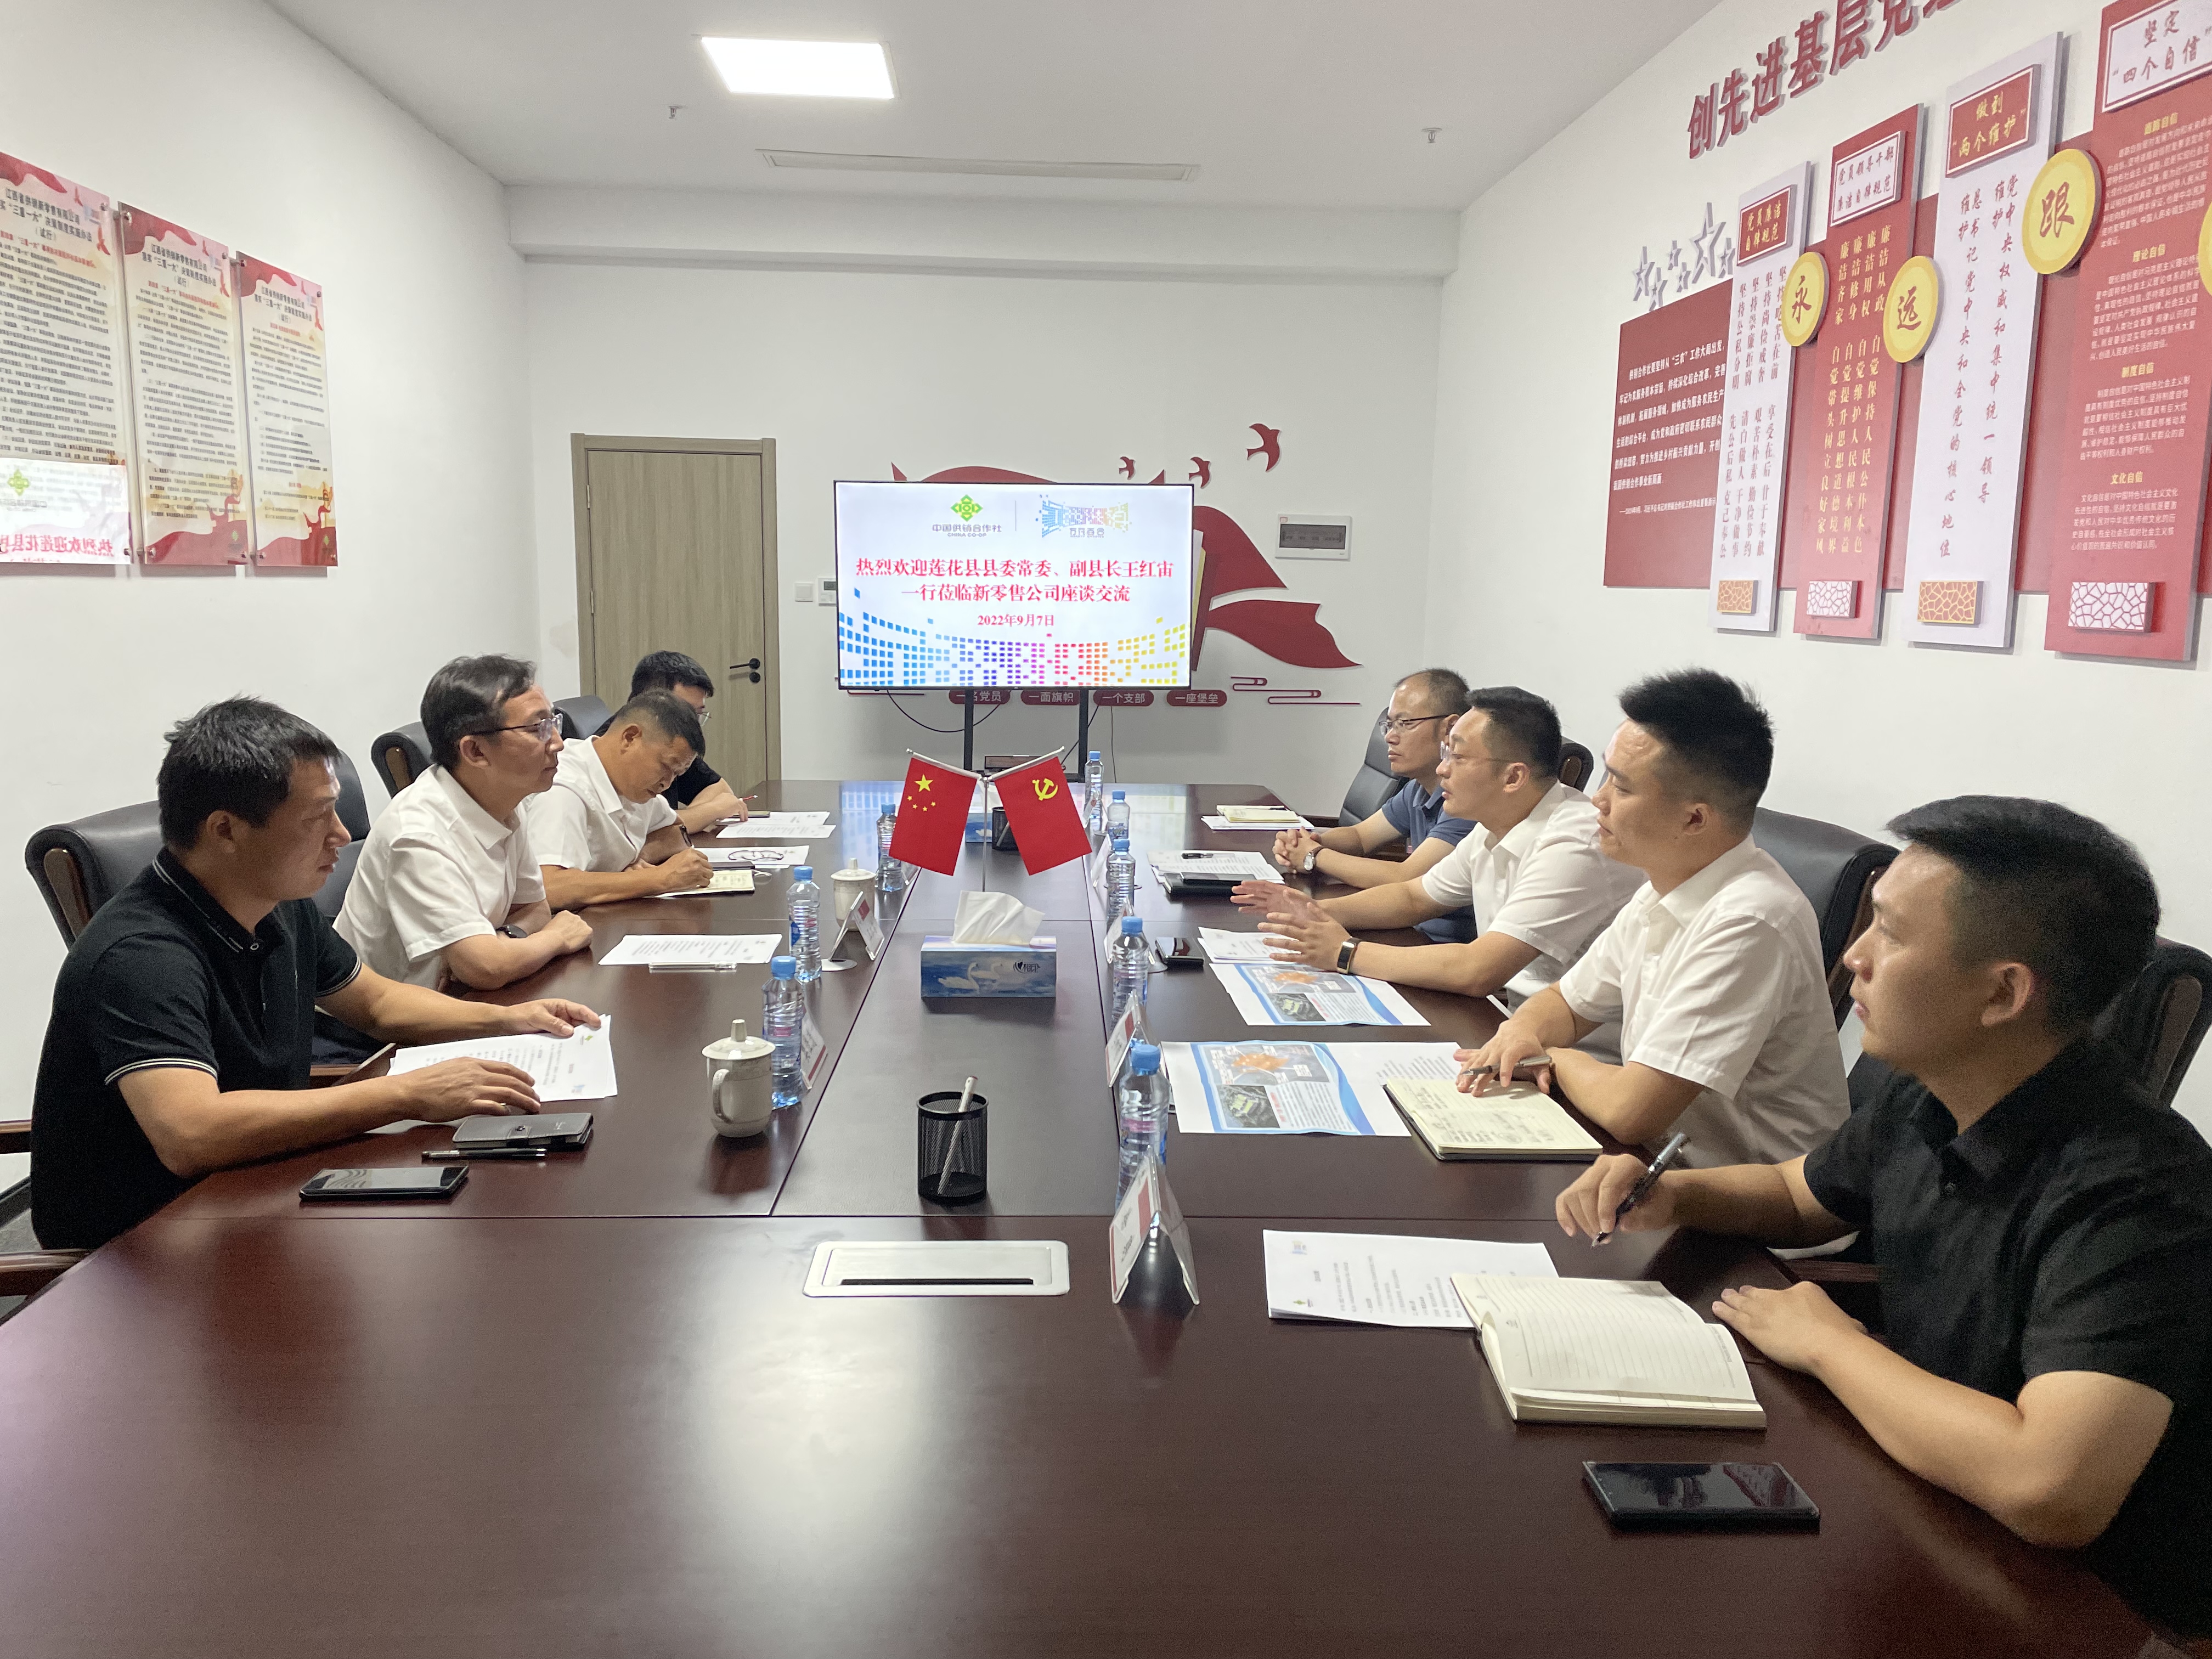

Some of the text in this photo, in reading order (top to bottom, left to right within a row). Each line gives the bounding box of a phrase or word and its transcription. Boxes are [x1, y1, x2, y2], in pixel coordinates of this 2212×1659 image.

[2144, 10, 2179, 48] 坚定
[1688, 0, 1967, 159] 创先进基层党
[1976, 91, 2004, 121] 做到
[1838, 146, 1894, 185] 党员领导干部
[1837, 174, 1891, 212] 廉洁自律规范
[1747, 200, 1781, 231] 党员廉洁
[2040, 182, 2075, 238] 跟
[1746, 222, 1779, 251] 自律规范
[1874, 224, 1891, 312] 廉洁从政
[2133, 244, 2165, 262] 理论自信
[1835, 241, 1849, 326] 廉洁齐家
[1849, 235, 1863, 321] 廉洁修身
[1861, 230, 1876, 318] 廉洁用权
[1792, 275, 1812, 324] 永
[1898, 285, 1922, 330] 远
[1732, 283, 1746, 390] 坚持公私分明
[2121, 362, 2155, 377] 制度自信
[2111, 471, 2143, 484] 文化自信
[932, 524, 1002, 533] 中国供销合作社
[856, 558, 1174, 578] 热烈欢迎莲花县县委常委、副县长王红宙
[901, 584, 1131, 602] 一行莅临新零售公司座谈交流
[977, 613, 1055, 627] 2022年9月7日
[1029, 692, 1074, 703] 一面旗帜
[1102, 693, 1146, 703] 一个支部
[1175, 693, 1218, 704] 一座堡垒
